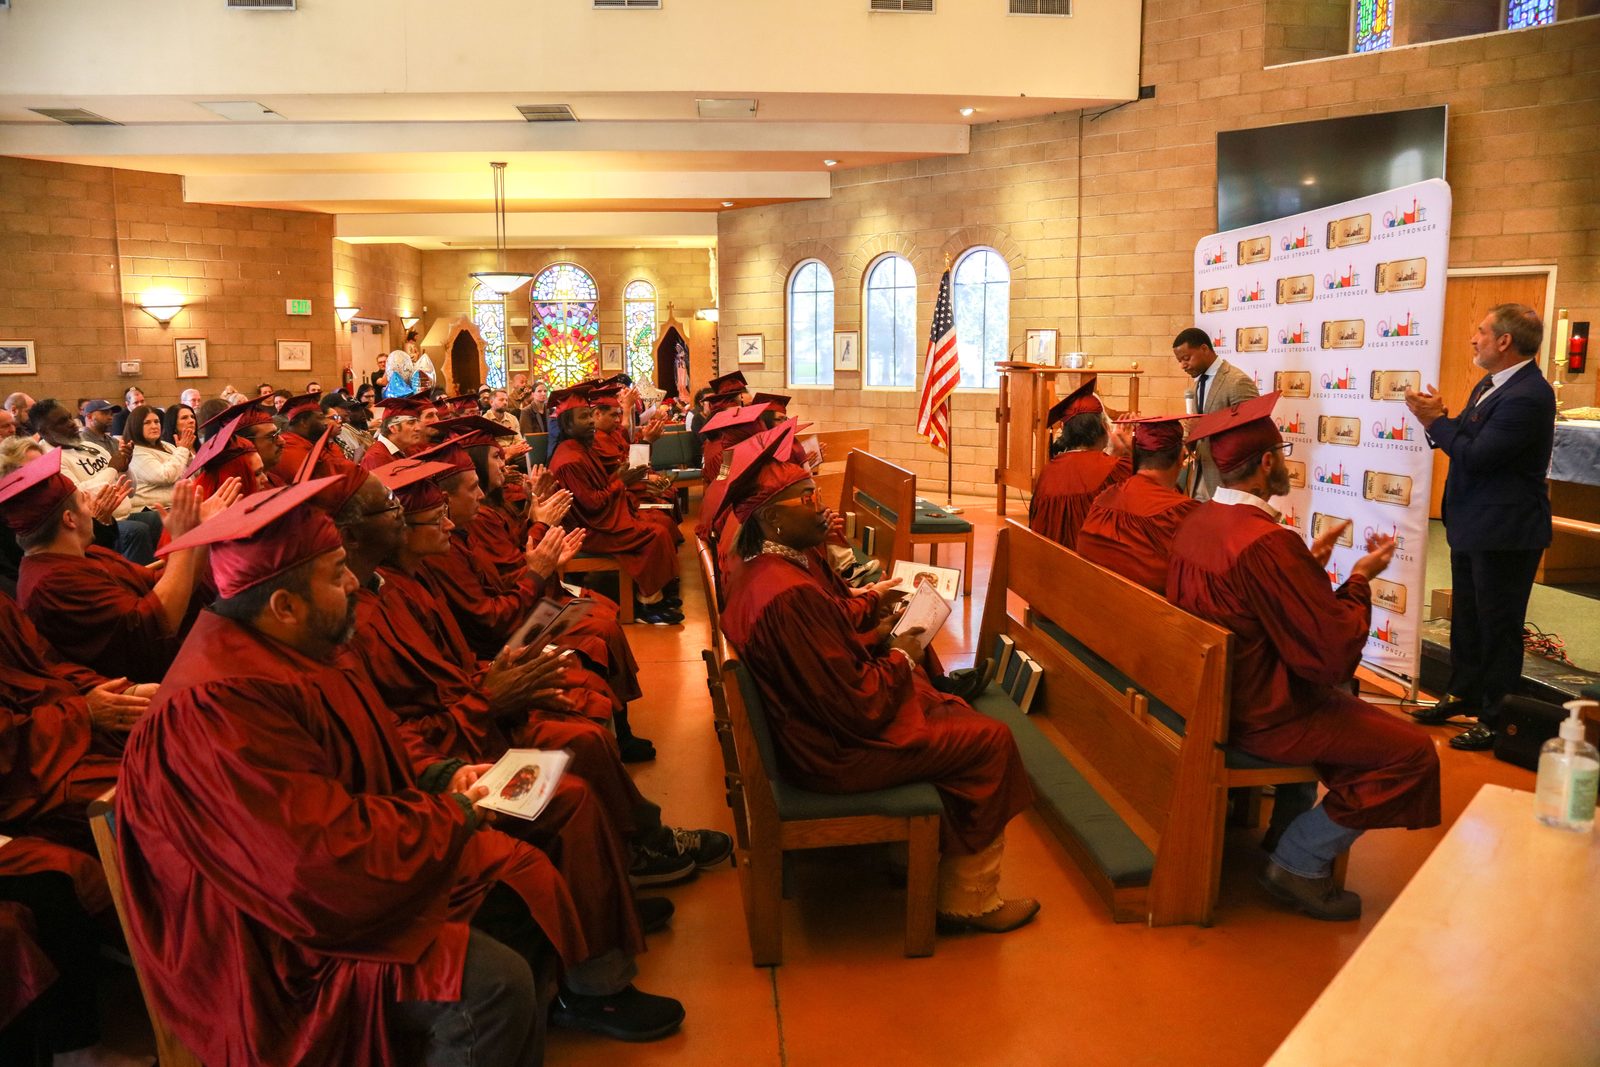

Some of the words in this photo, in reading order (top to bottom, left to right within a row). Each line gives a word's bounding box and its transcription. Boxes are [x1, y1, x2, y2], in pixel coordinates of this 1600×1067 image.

[1374, 233, 1394, 241] VEGAS
[1398, 224, 1436, 237] STRONGER
[1292, 249, 1320, 258] STRONGER
[1336, 290, 1368, 298] STRONGER
[1386, 444, 1423, 452] STRONGER
[1326, 486, 1358, 497] STRONGER
